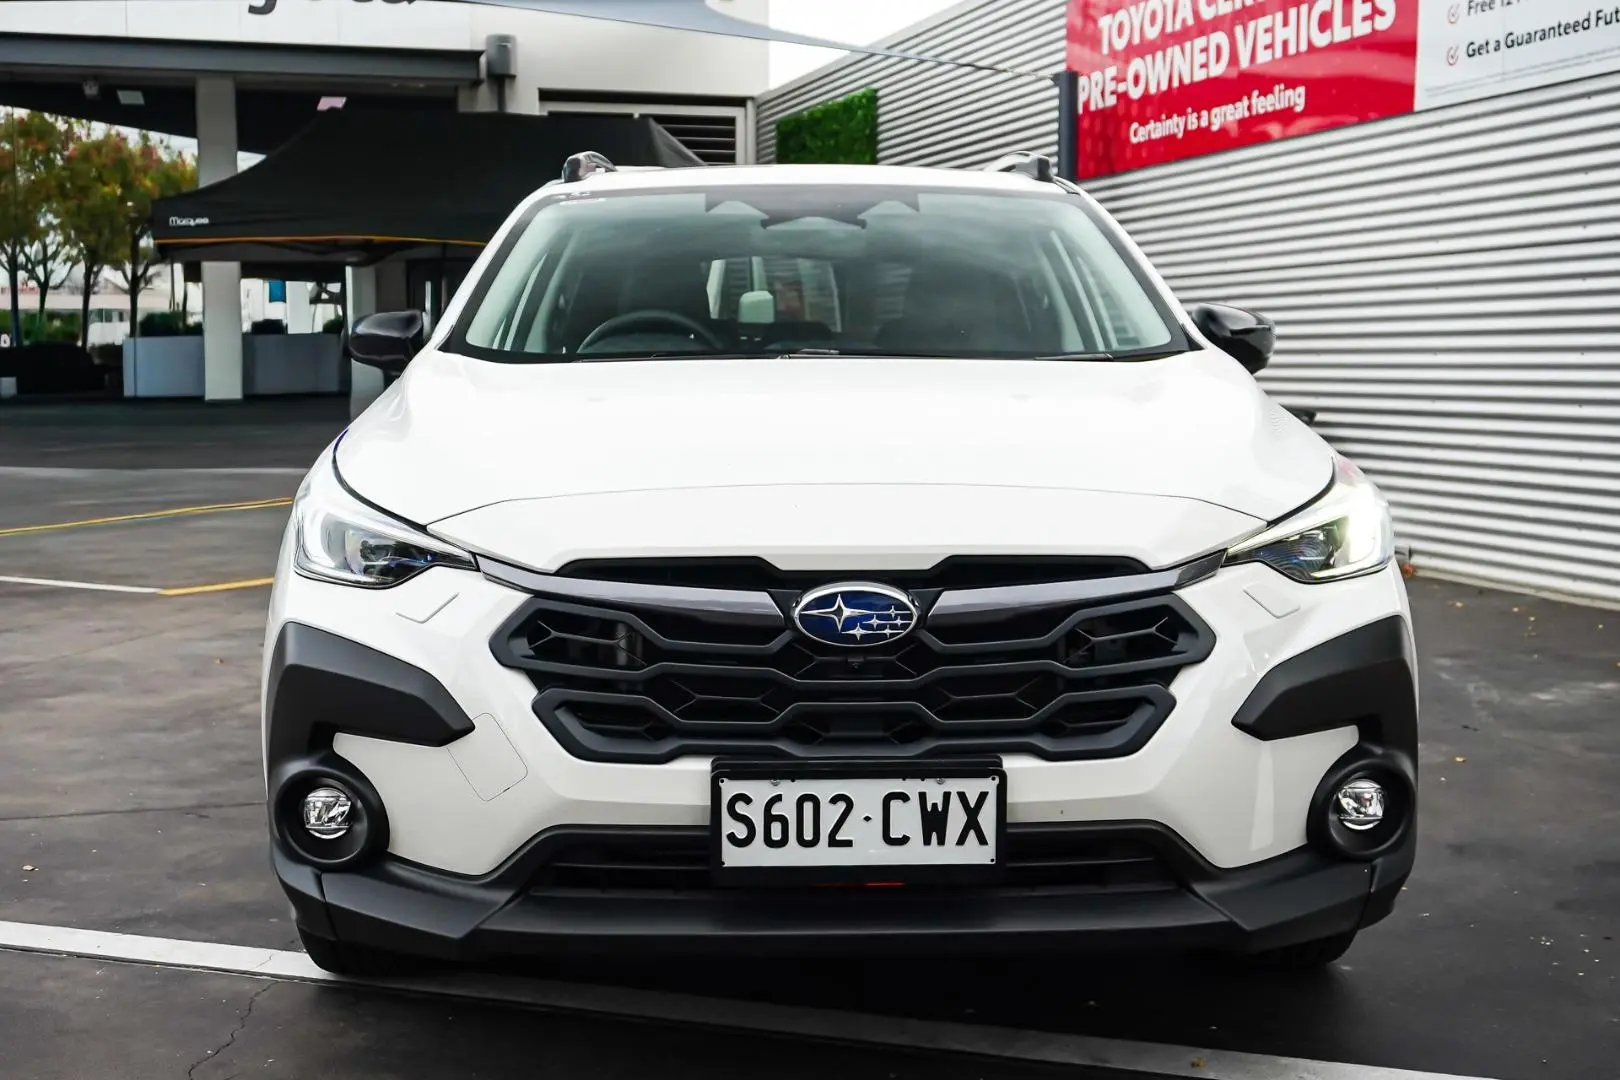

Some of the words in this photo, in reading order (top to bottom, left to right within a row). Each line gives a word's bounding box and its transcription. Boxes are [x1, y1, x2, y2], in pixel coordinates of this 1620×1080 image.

[1098, 0, 1194, 55] TOYOTA
[1466, 40, 1491, 58] Get
[1493, 40, 1501, 52] a
[1504, 10, 1591, 49] Guaranteed
[1077, 30, 1230, 115] PRE-OWNED
[1233, 0, 1396, 70] VEHICLES
[1129, 112, 1186, 144] Certainty
[1186, 106, 1199, 131] is
[1199, 109, 1209, 128] a
[1210, 95, 1250, 132] great
[1251, 83, 1306, 115] feeling
[726, 792, 854, 848] S602
[882, 791, 990, 847] CWX
